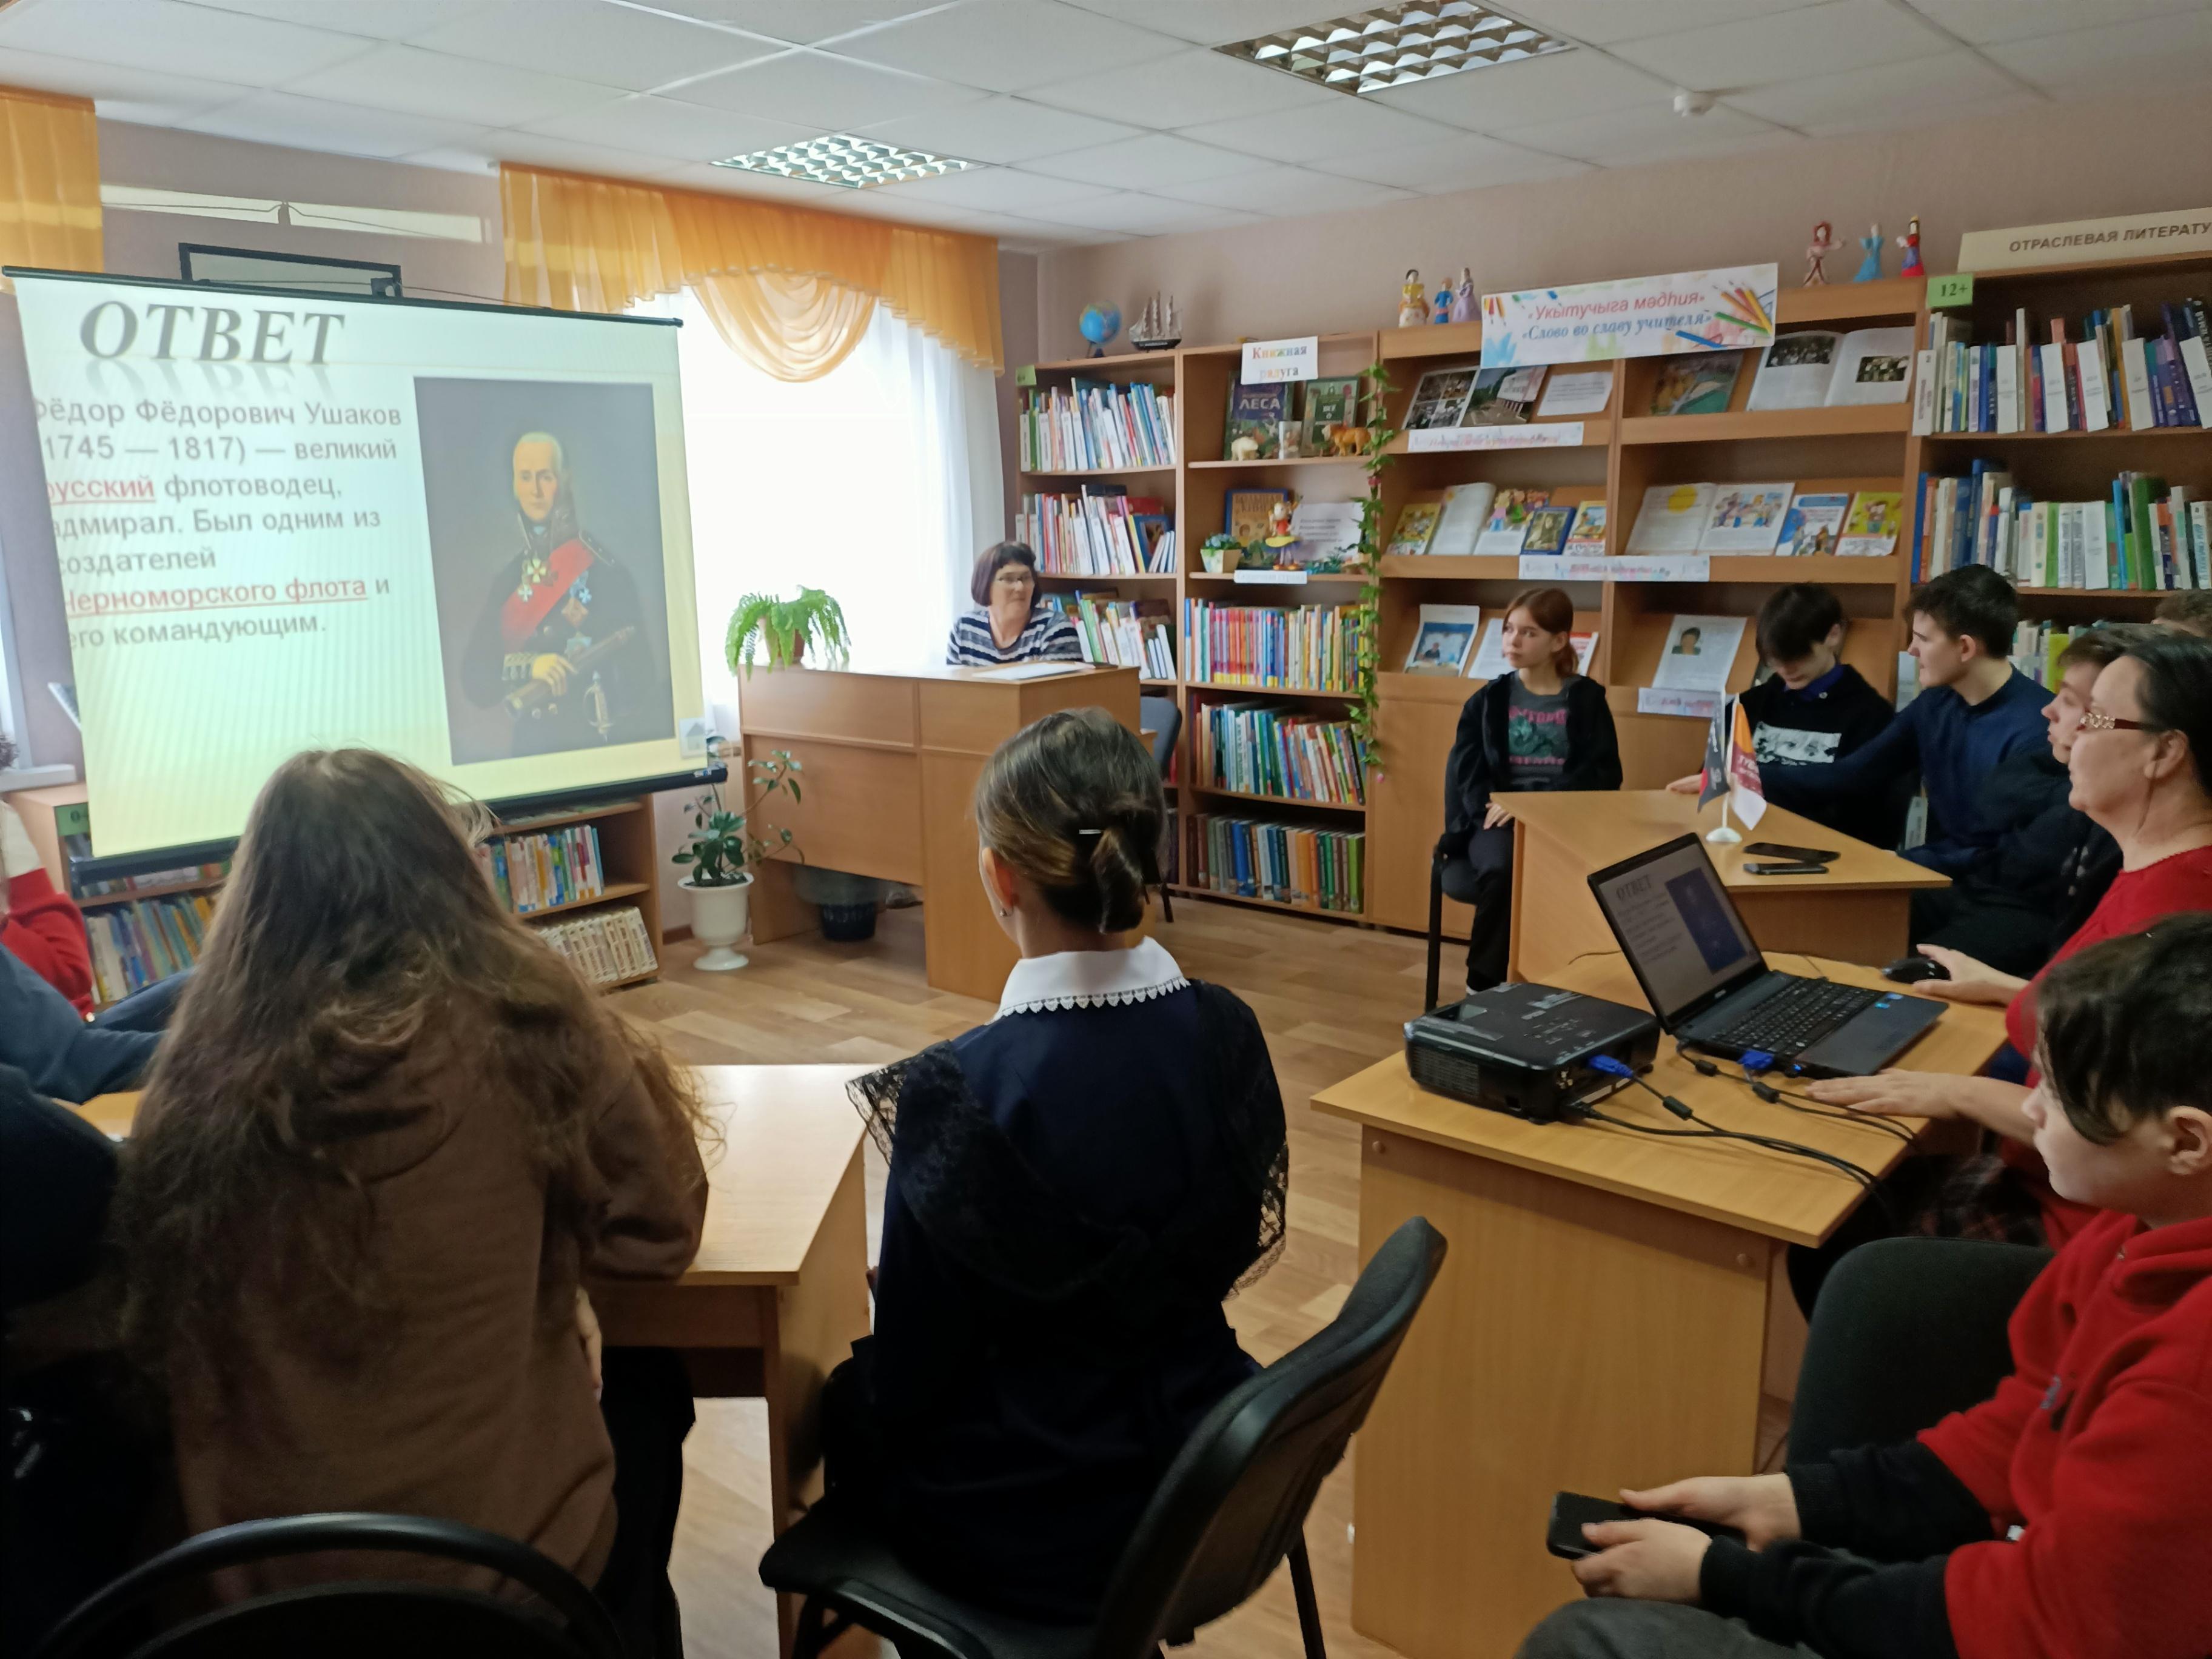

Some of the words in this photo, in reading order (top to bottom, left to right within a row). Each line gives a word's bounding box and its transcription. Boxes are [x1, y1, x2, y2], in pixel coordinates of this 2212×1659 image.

[2009, 232, 2119, 252] ОТРАСЛЕВАЯ
[1940, 284, 1968, 298] 12+
[79, 301, 346, 365] ОТВЕТ
[1523, 326, 1569, 340] «Слово
[1573, 325, 1589, 336] во
[1592, 323, 1632, 338] славу
[1637, 312, 1712, 332] учителя»
[1253, 346, 1307, 359] Книжная
[1260, 367, 1299, 380] радуга
[136, 399, 295, 429] Фёдорович
[304, 401, 401, 426] Ушаков
[1239, 397, 1281, 411] ЛЕСА
[169, 437, 246, 465] 1817)
[295, 437, 397, 460] великий
[165, 475, 342, 500] флотоводец,
[194, 508, 253, 532] Был
[263, 508, 343, 532] одним
[354, 509, 381, 528] из
[285, 577, 366, 606] флота
[376, 579, 390, 595] и
[113, 614, 326, 646] командующим.
